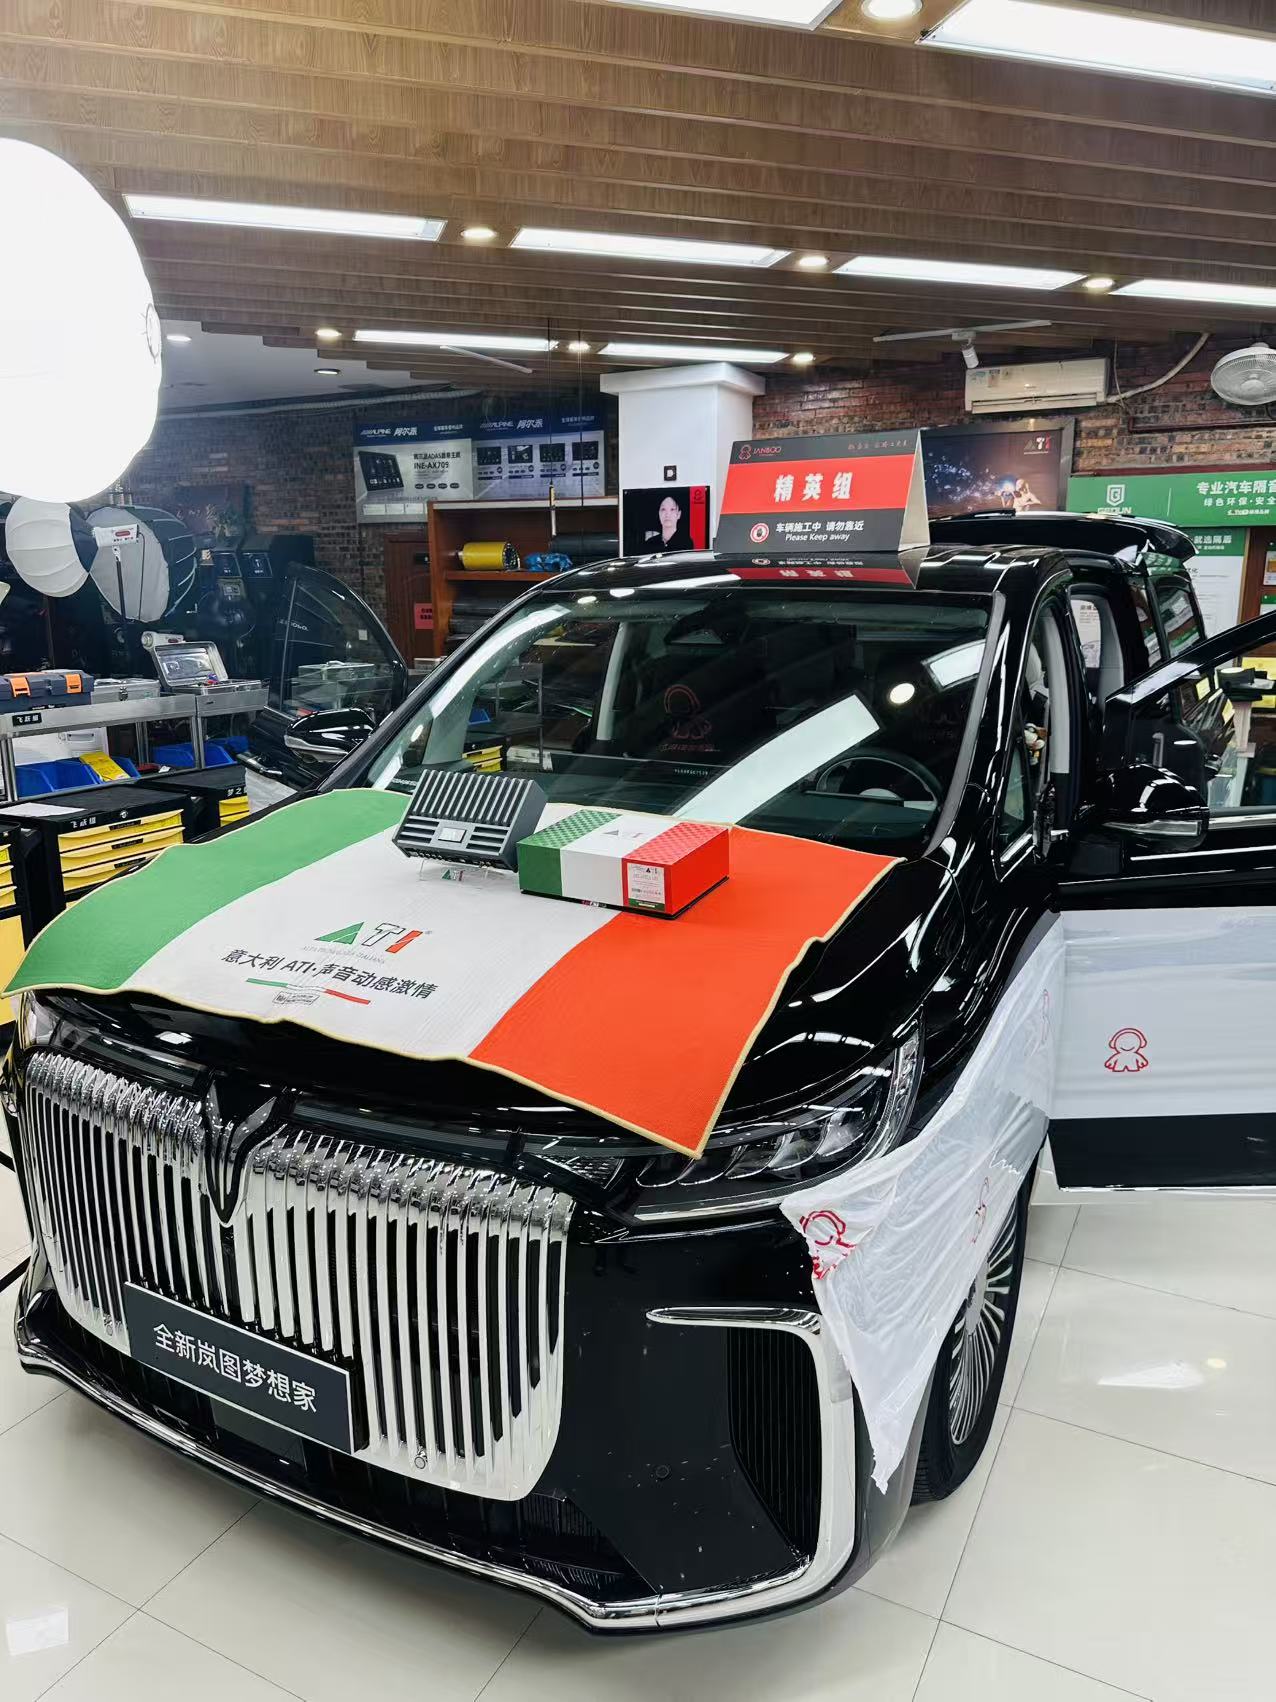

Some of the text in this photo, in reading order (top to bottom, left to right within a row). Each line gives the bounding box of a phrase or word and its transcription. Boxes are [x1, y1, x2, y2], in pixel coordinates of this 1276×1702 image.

[517, 419, 543, 429] 阿尔派
[774, 471, 852, 503] 精英组
[775, 519, 864, 533] 车辆施工中 请勿靠近
[785, 533, 851, 542] Please Keep away
[315, 921, 423, 954] ATI
[222, 948, 285, 971] 意大利
[153, 1323, 317, 1414] 全新岚图梦想家
